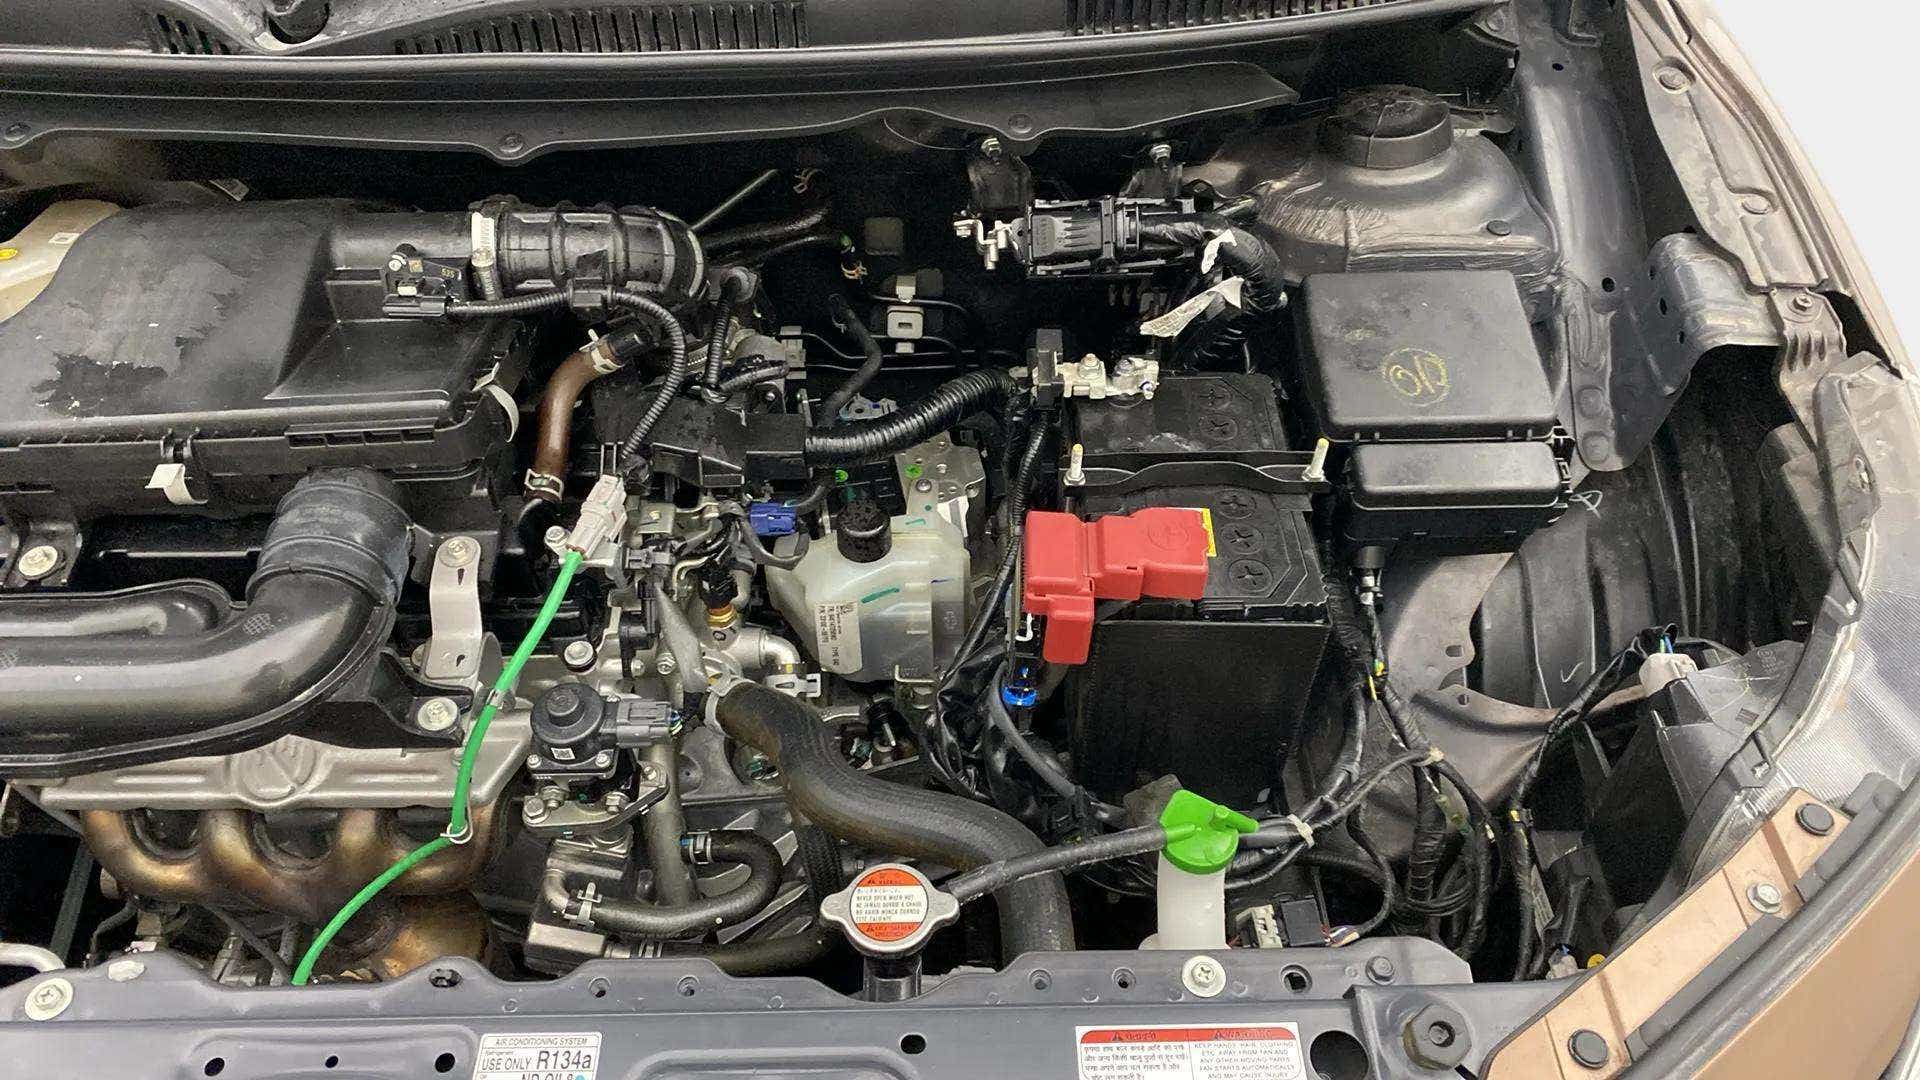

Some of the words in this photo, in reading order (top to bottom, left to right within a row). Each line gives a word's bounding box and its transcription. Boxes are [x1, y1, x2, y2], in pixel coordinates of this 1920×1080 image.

[495, 1038, 508, 1046] AIR
[508, 1037, 558, 1046] CONDITIONING
[559, 1037, 588, 1046] SYSTEM
[481, 1057, 502, 1071] USE
[504, 1057, 532, 1071] ONLY
[536, 1050, 592, 1070] R134a
